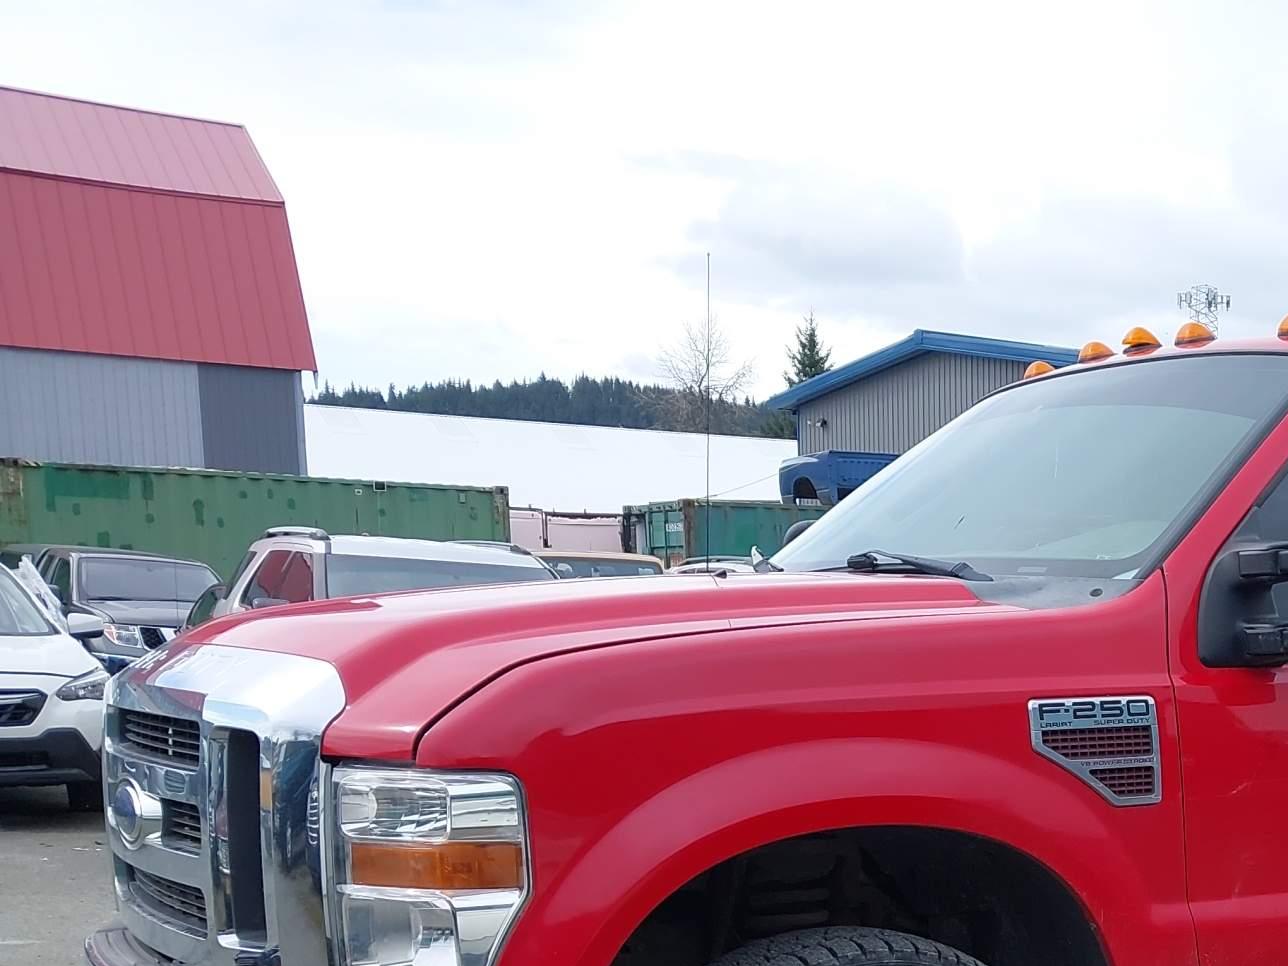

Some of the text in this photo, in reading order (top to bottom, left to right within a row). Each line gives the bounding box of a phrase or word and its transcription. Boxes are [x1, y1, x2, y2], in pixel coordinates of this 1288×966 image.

[1038, 699, 1150, 721] F-250
[1040, 720, 1073, 729] LARIAT
[1093, 717, 1150, 726] SUPER DUTY
